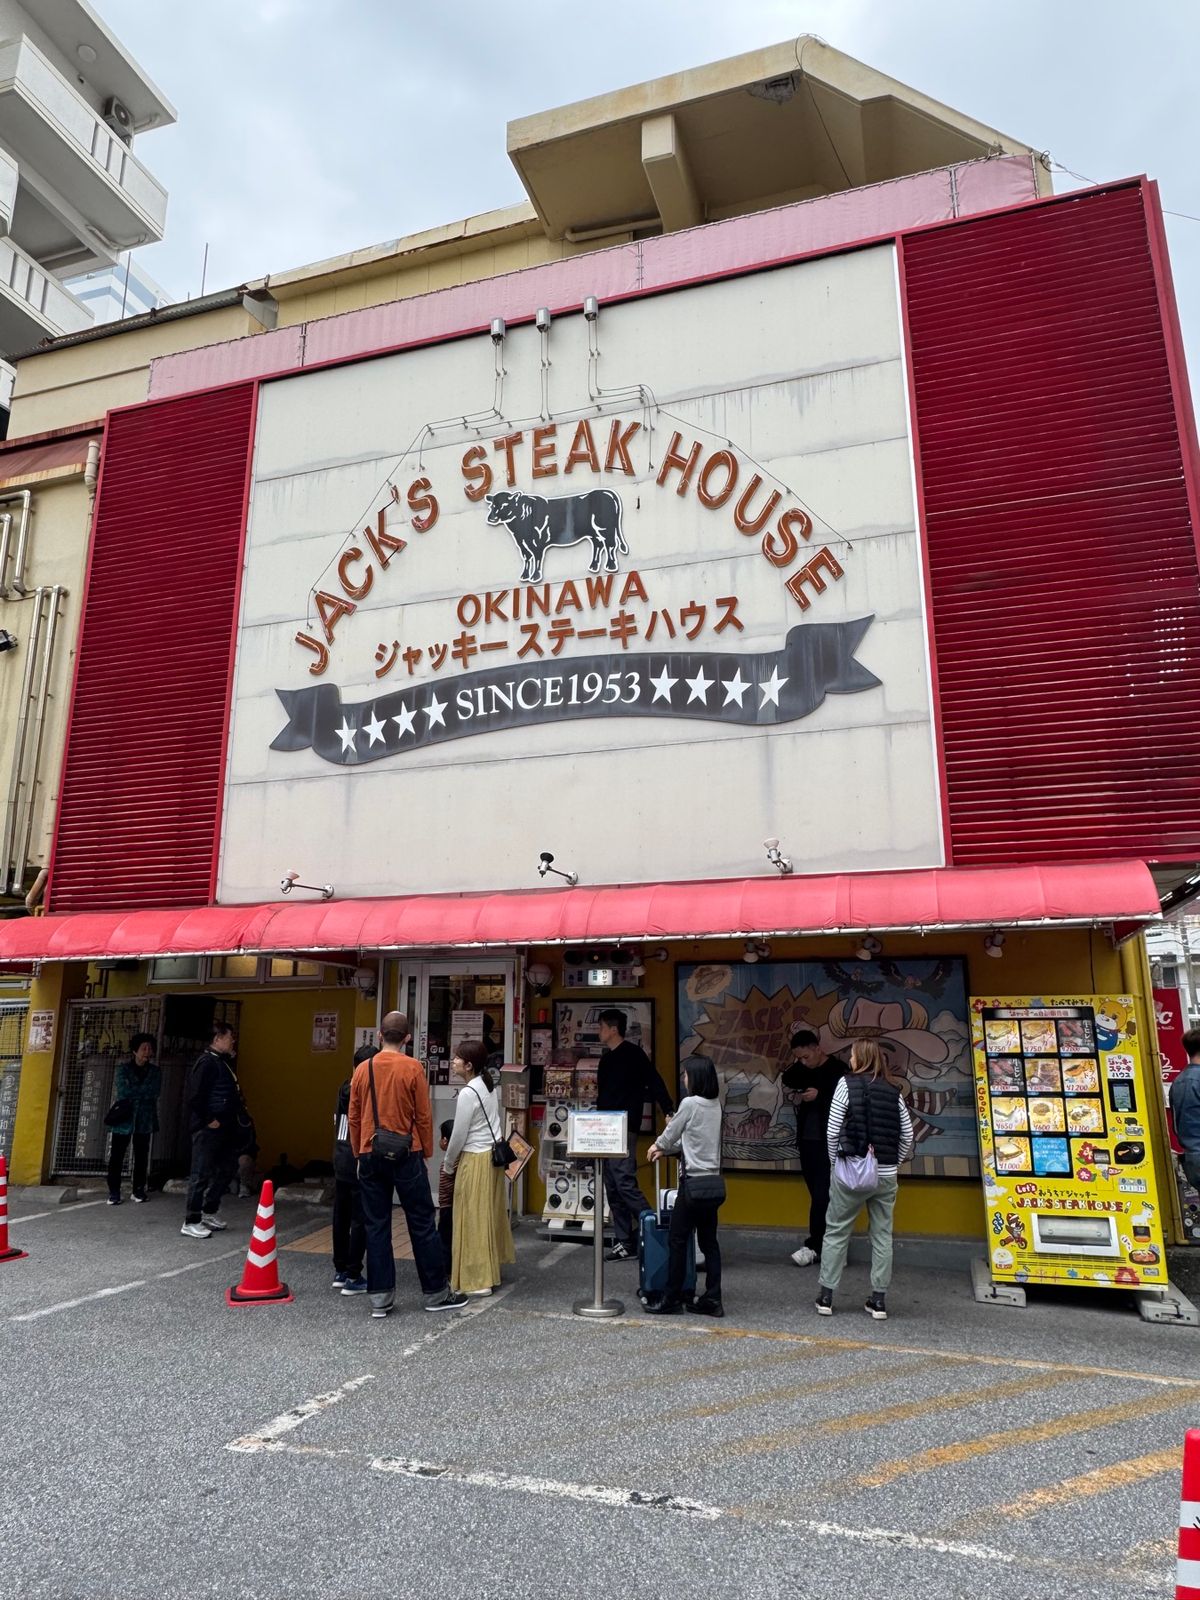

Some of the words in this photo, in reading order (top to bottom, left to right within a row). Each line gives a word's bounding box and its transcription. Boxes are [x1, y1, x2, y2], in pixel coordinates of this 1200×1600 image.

[295, 476, 440, 676] JACK'S
[461, 419, 643, 500] STEAK
[656, 430, 844, 611] HOUSE
[457, 571, 648, 627] OKINAWA
[1016, 1184, 1036, 1194] Let's
[1053, 1199, 1087, 1210] STEAK
[1087, 1201, 1124, 1212] HOUSE
